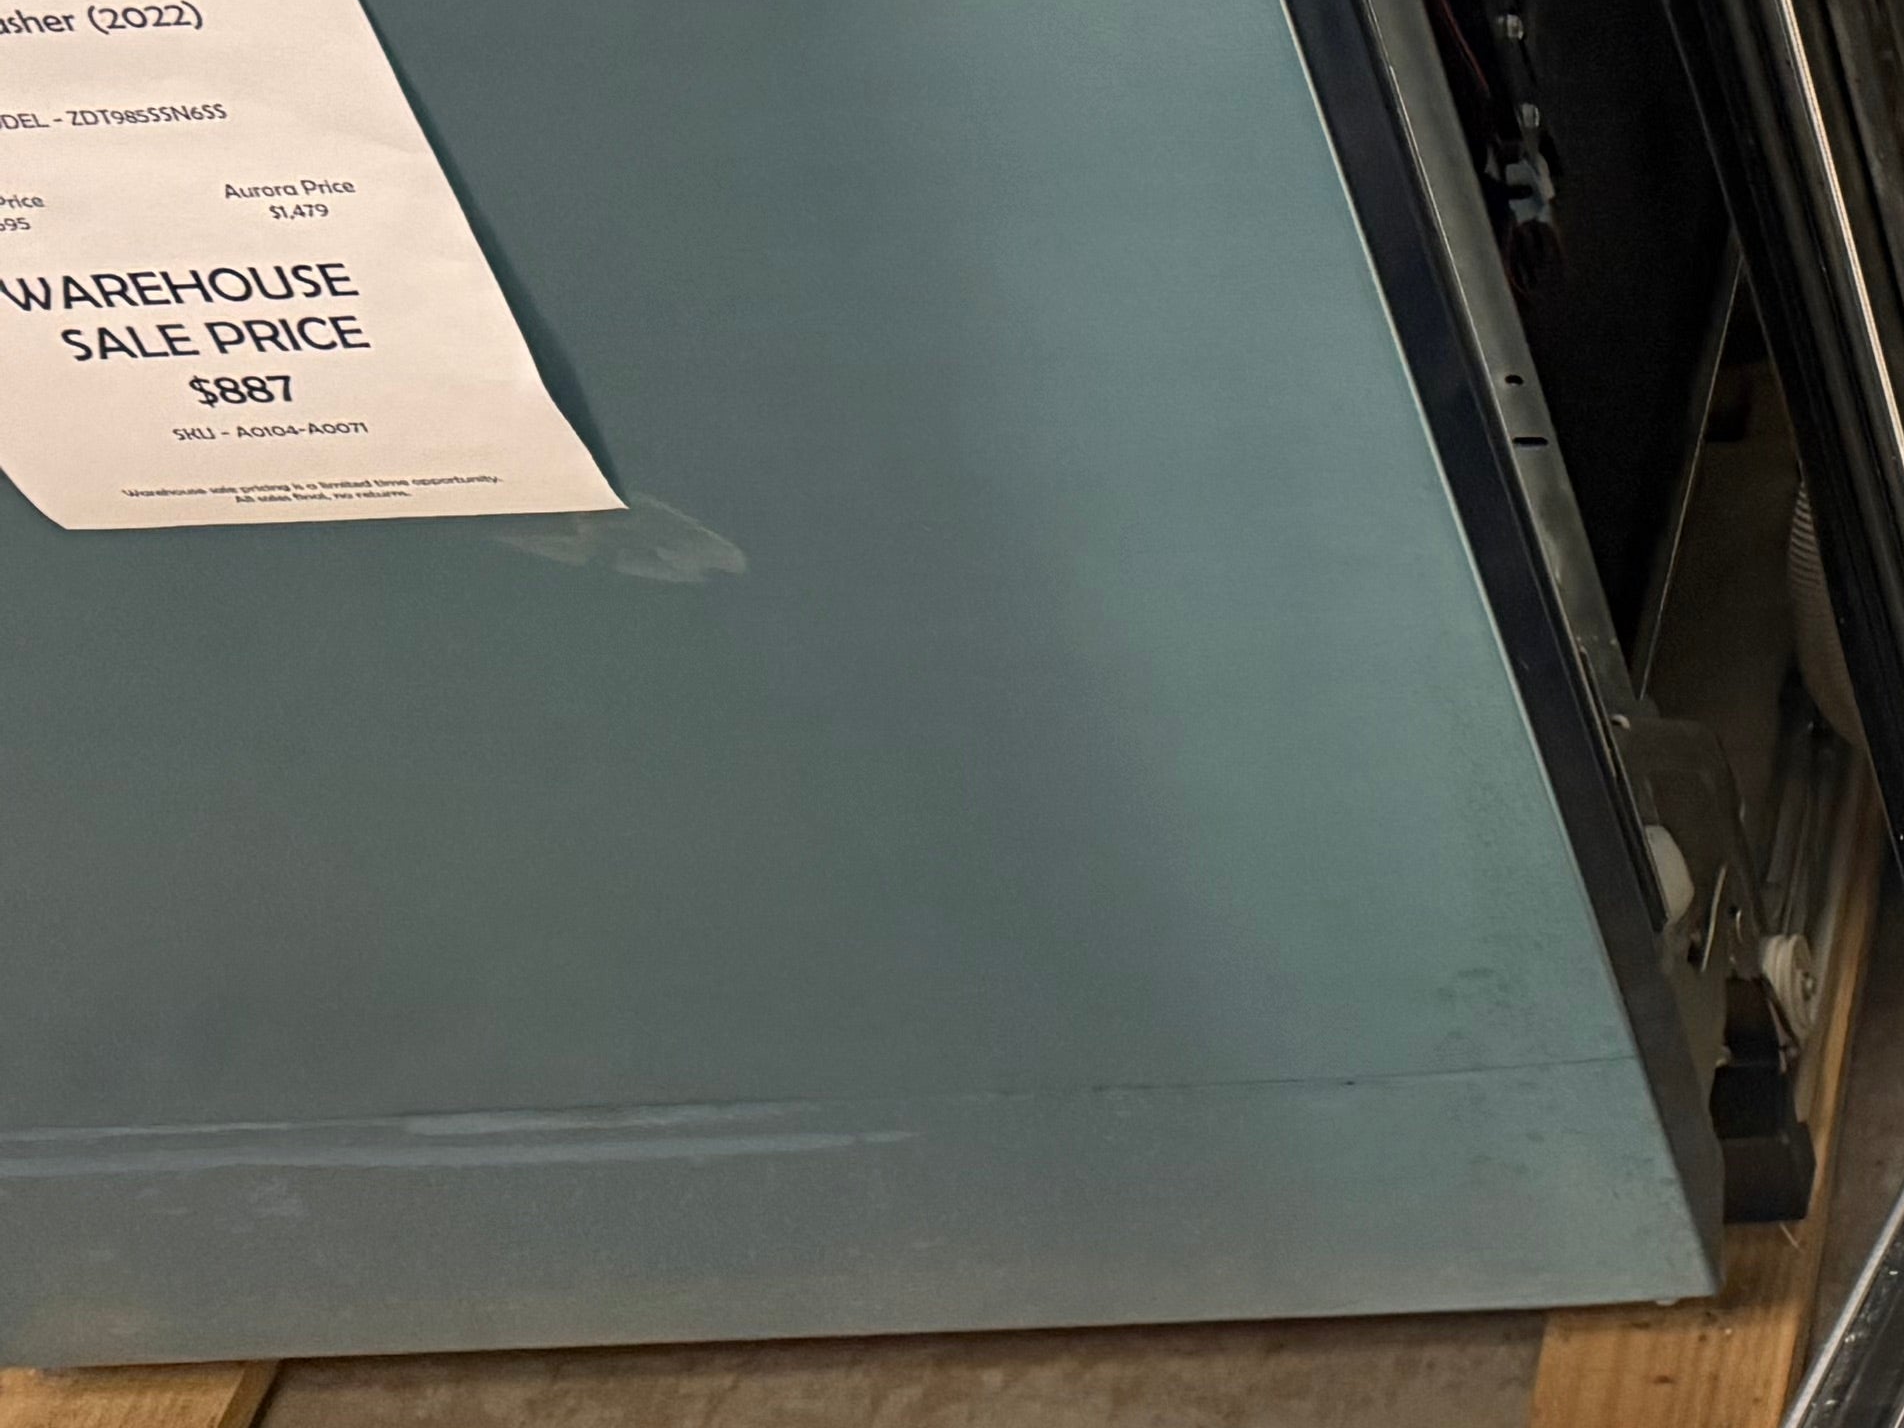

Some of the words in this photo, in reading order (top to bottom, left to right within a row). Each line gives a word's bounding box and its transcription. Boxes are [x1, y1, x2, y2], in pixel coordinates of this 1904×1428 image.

[87, 0, 203, 35] (2022)
[225, 183, 299, 200] Aurora
[300, 179, 357, 196] Price
[0, 263, 359, 311] WAREHOUSE
[61, 323, 200, 361] SALE
[204, 315, 371, 354] PRICE
[189, 375, 293, 408] $887
[173, 427, 217, 441] SKU
[236, 421, 370, 438] A0104-A0071
